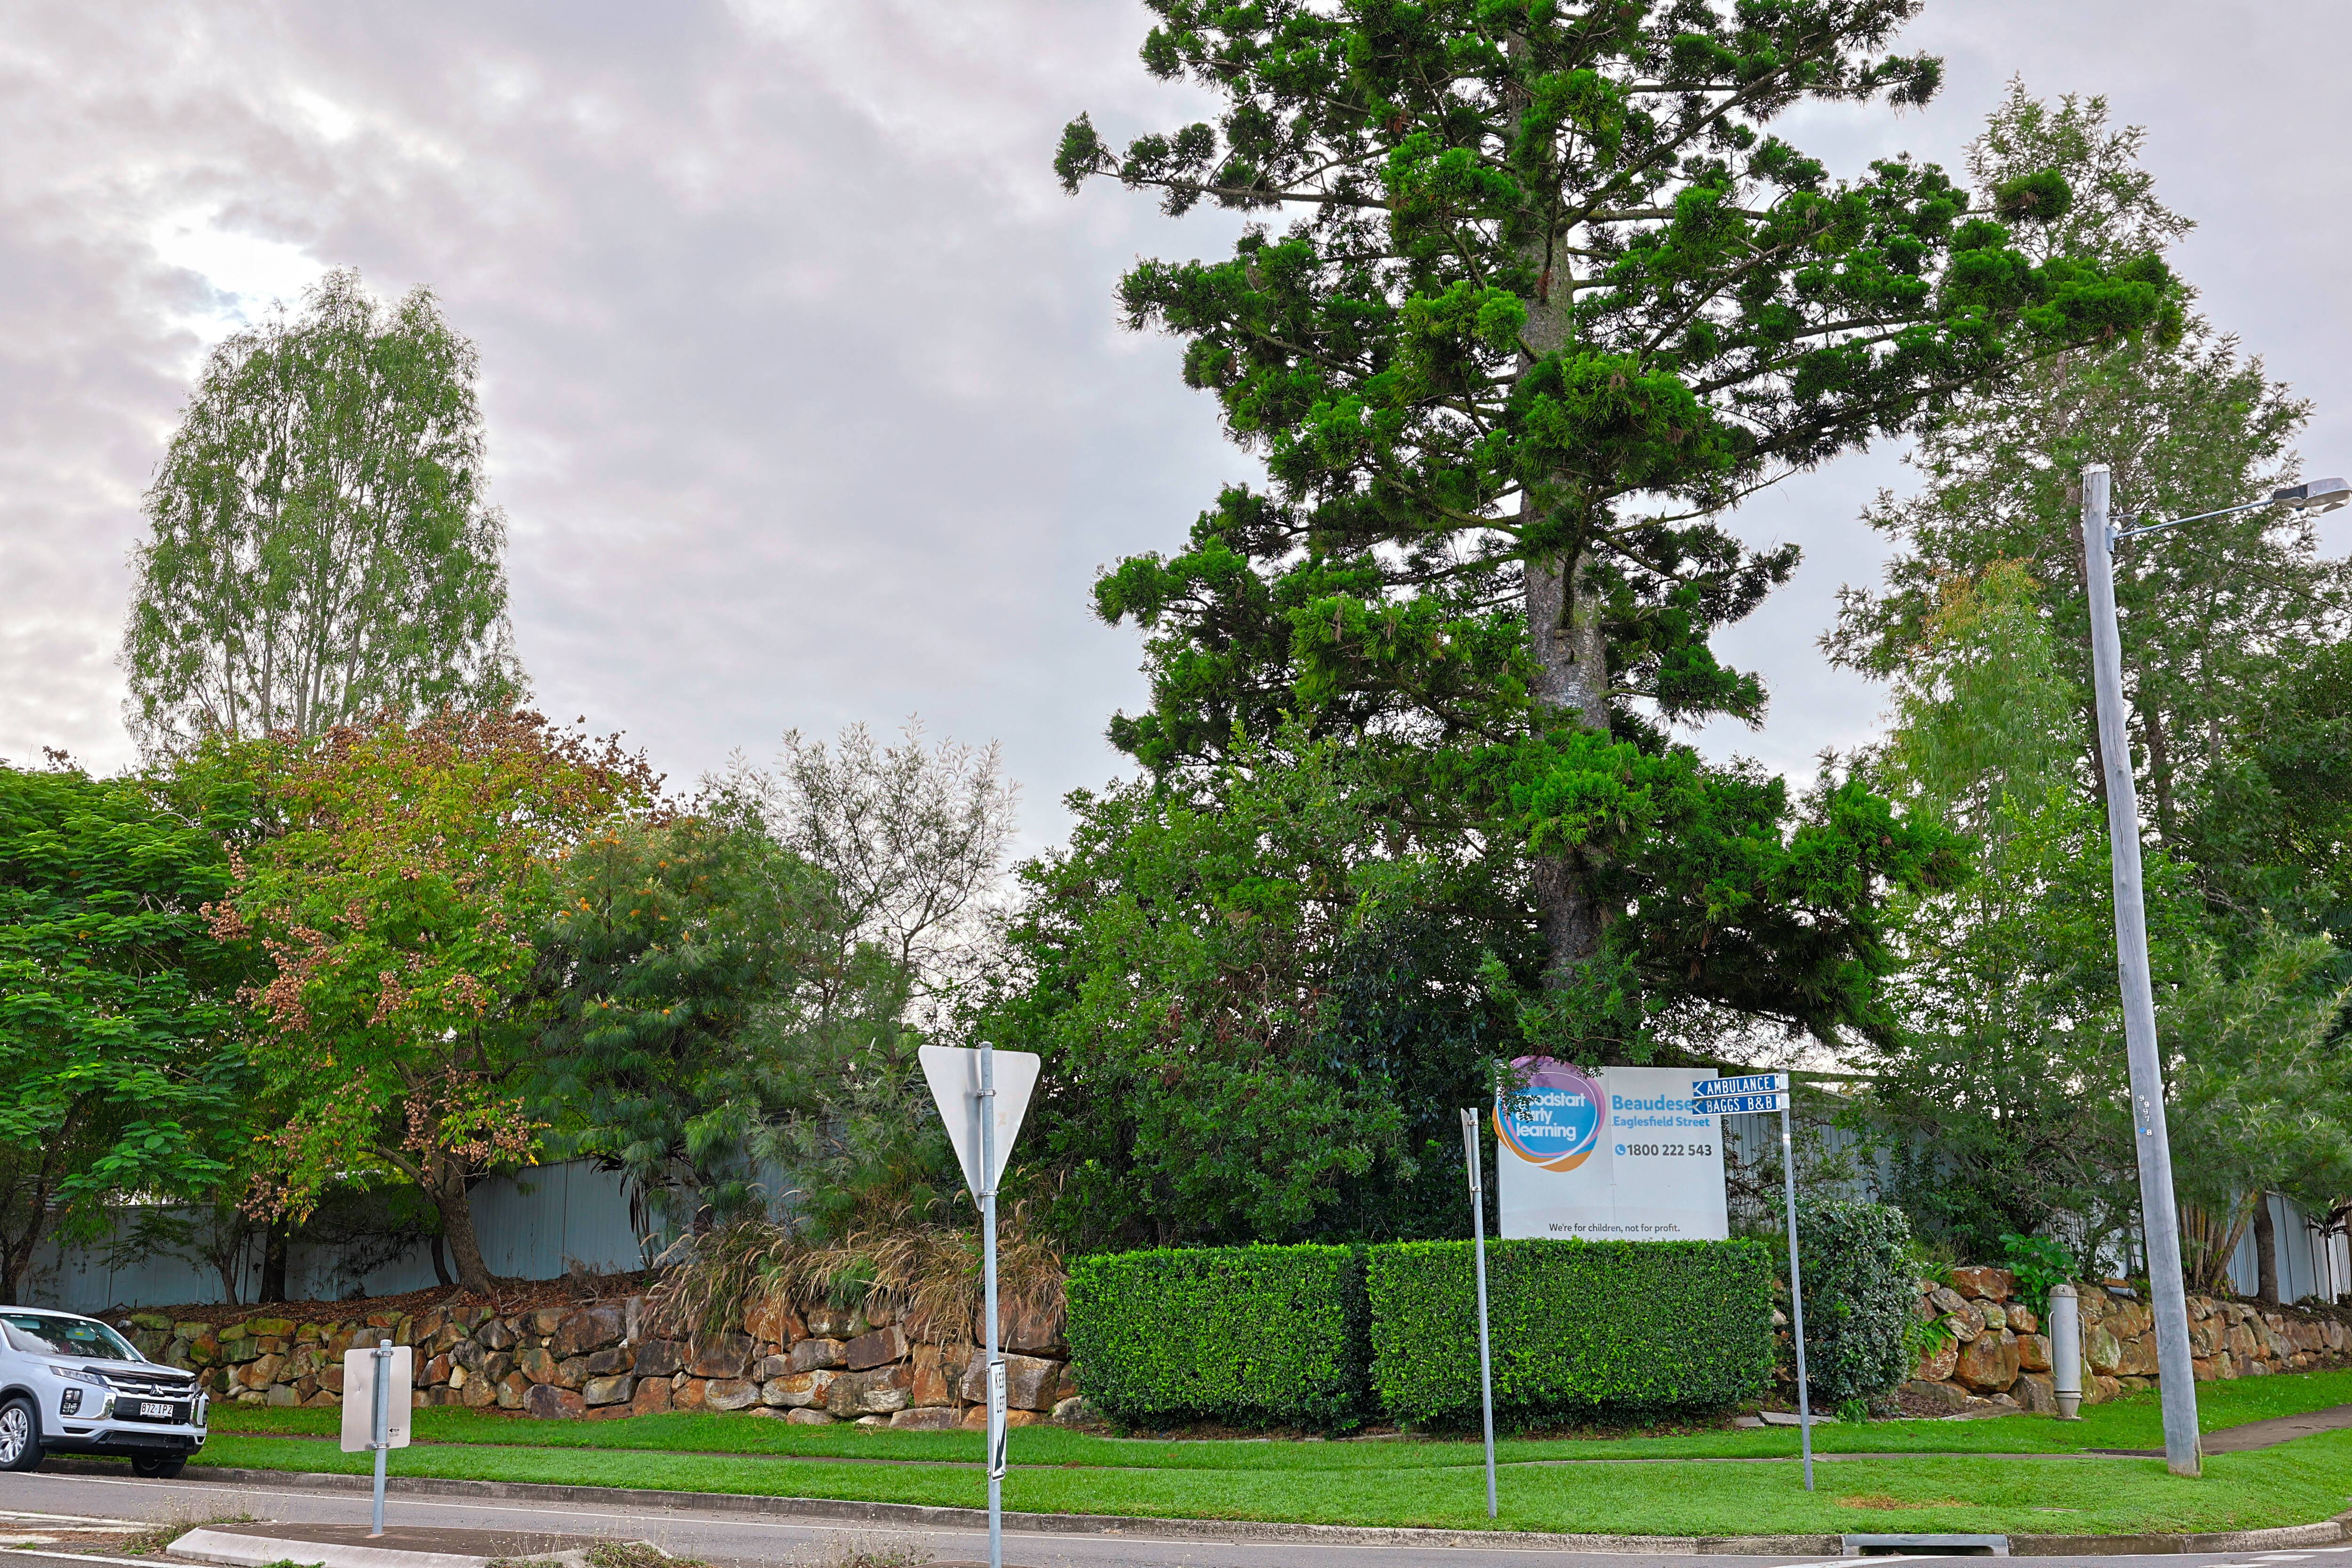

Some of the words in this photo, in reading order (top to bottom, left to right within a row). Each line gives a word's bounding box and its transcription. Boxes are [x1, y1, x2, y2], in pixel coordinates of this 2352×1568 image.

[1707, 1077, 1770, 1095] AMBULANCE
[1612, 1094, 1692, 1111] Beaudese
[1707, 1098, 1740, 1113] BAGGS
[1748, 1096, 1772, 1110] B&B
[1613, 1115, 1673, 1129] Eaglesfield
[1676, 1116, 1710, 1127] Street
[1516, 1122, 1576, 1142] learning
[1627, 1144, 1659, 1156] 1800
[1662, 1144, 1685, 1156] 222
[1688, 1144, 1712, 1156] 543
[1549, 1223, 1572, 1232] We're
[1574, 1223, 1586, 1232] for
[1588, 1223, 1623, 1233] children,
[1655, 1224, 1680, 1234] profit.
